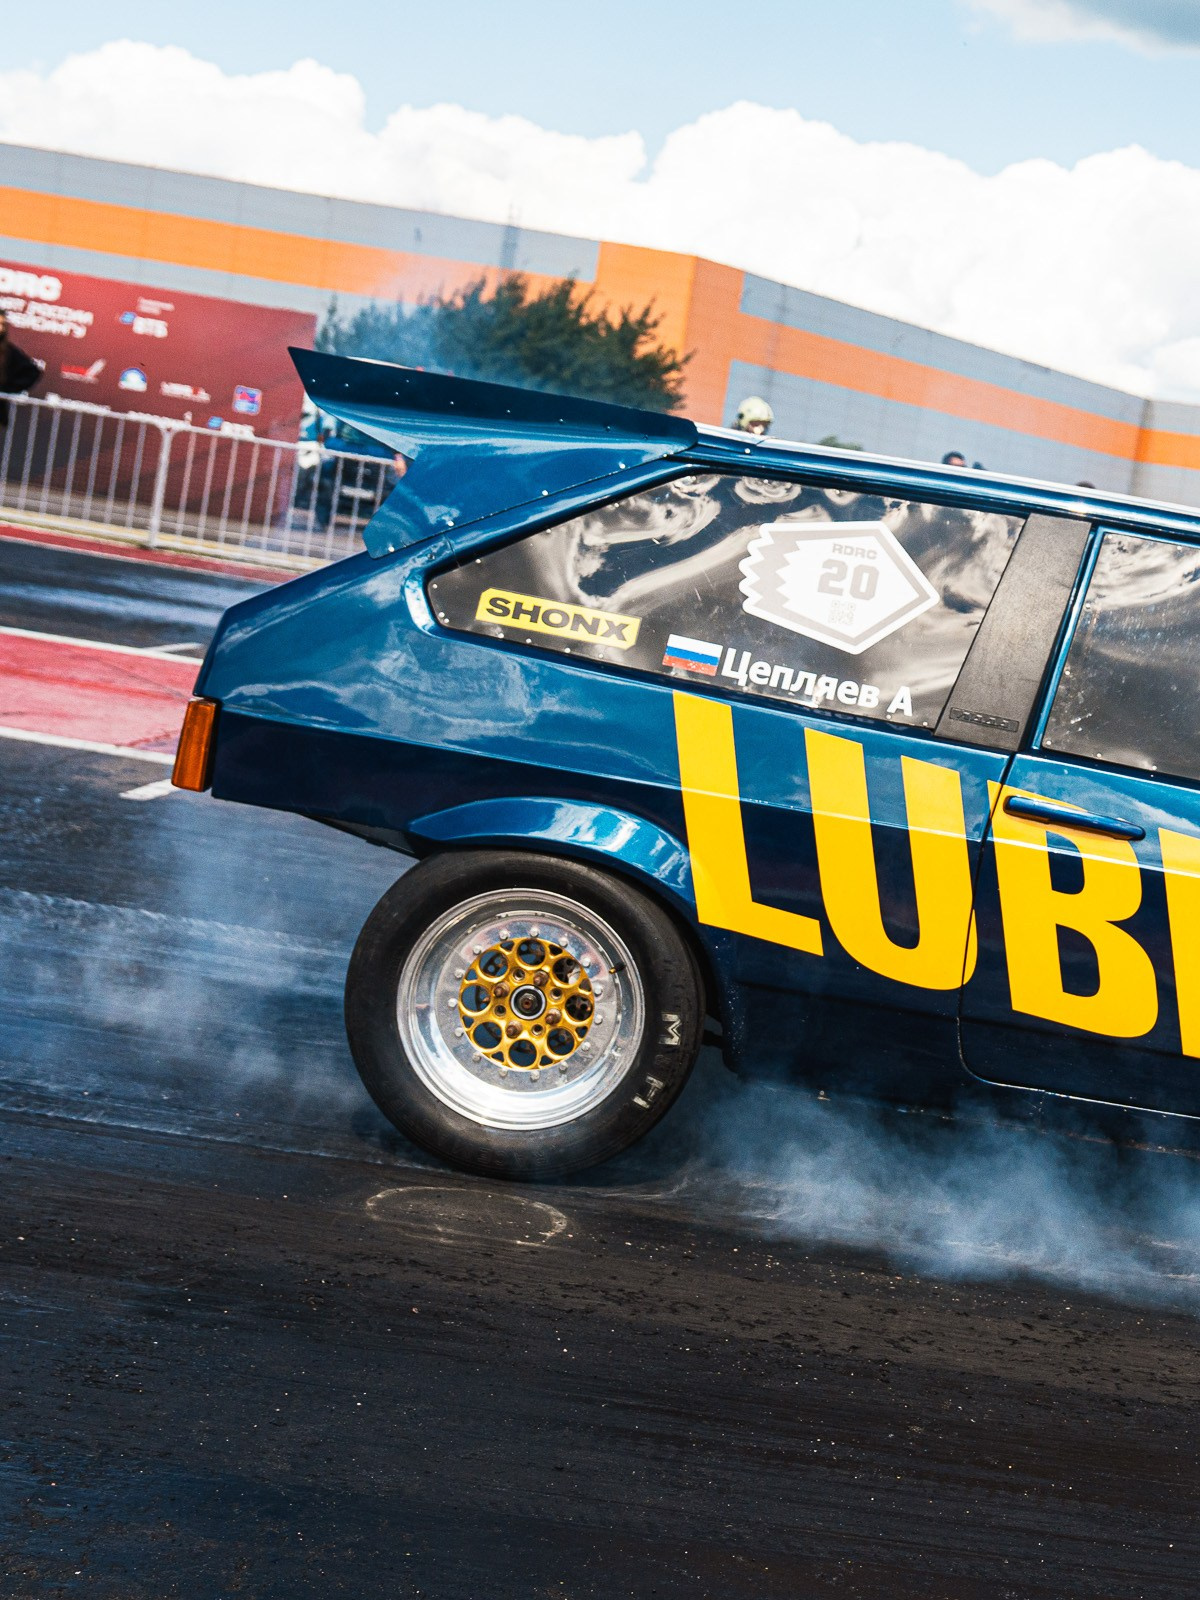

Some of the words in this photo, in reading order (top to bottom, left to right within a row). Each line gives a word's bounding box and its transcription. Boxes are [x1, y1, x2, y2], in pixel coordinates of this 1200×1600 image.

[832, 543, 878, 560] RDRC
[817, 558, 880, 601] 20
[486, 597, 629, 642] SHONX
[721, 647, 880, 709] Цепляев
